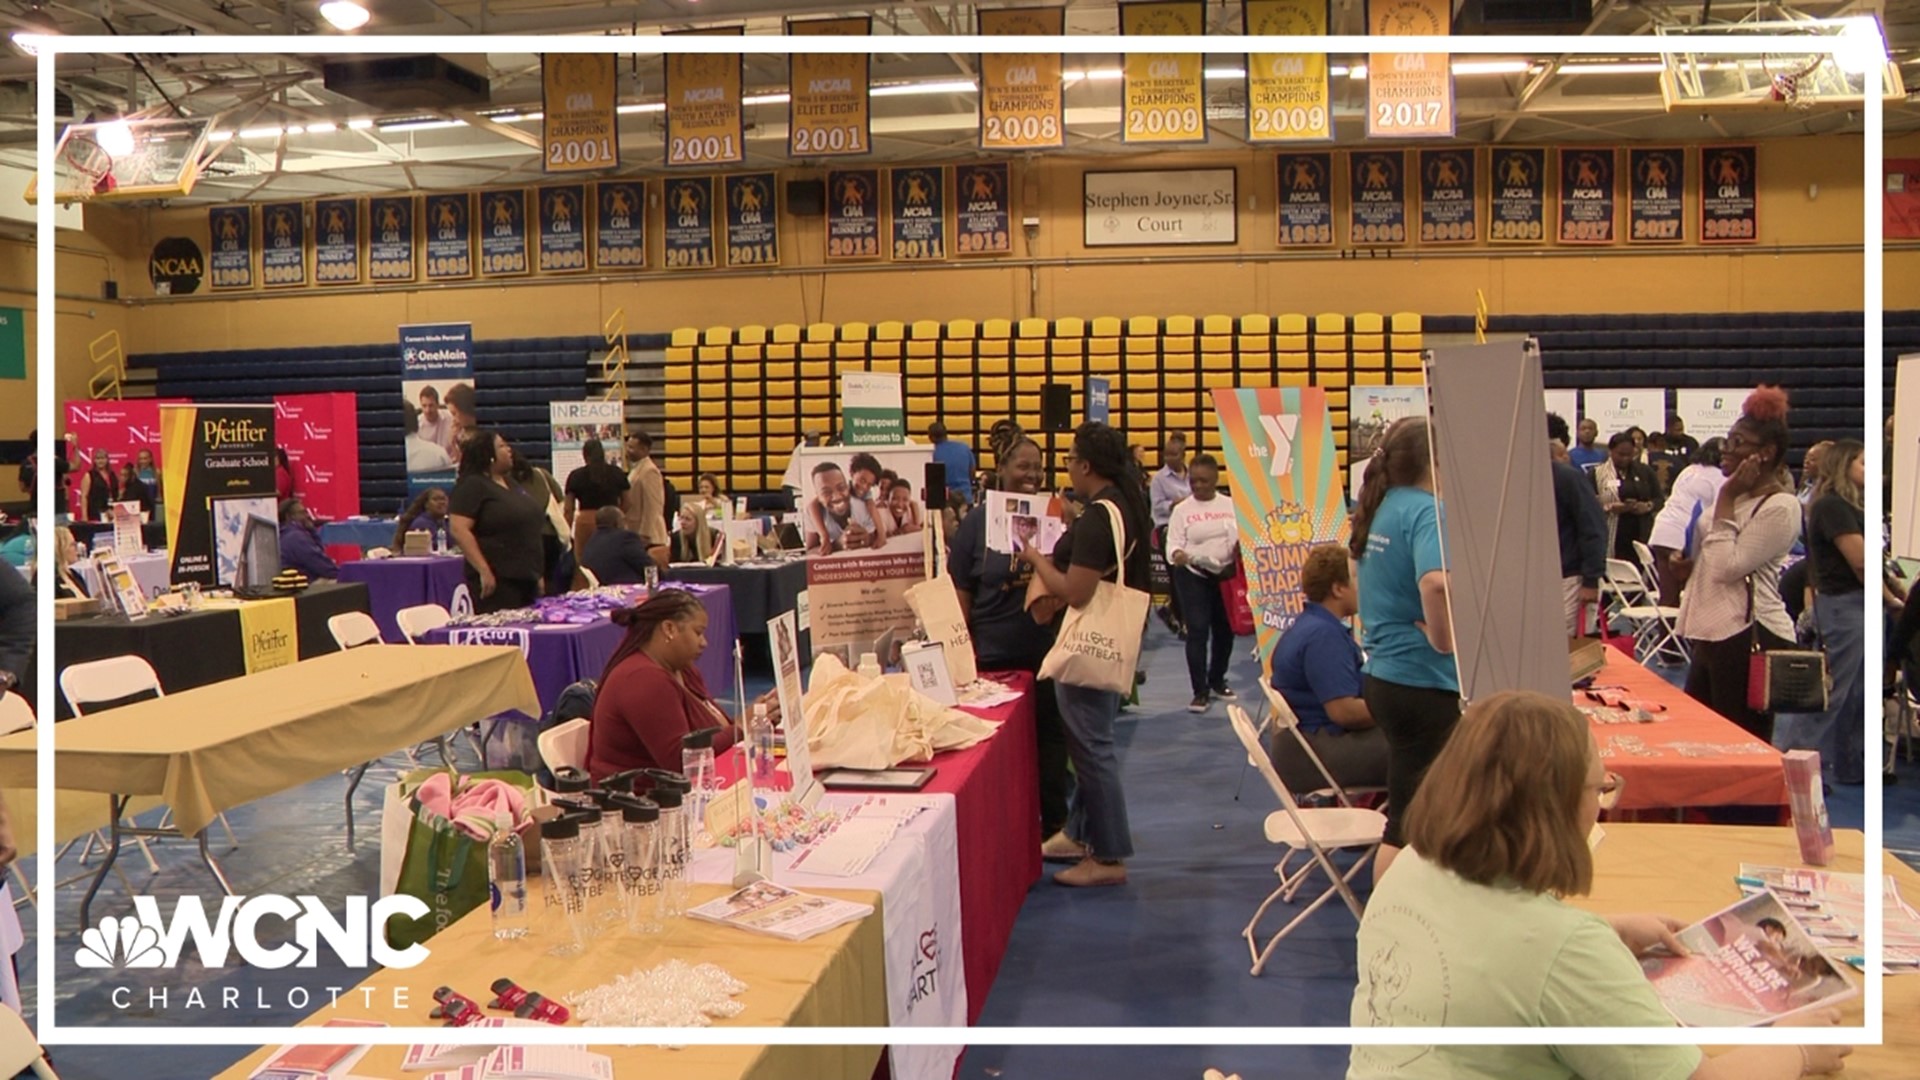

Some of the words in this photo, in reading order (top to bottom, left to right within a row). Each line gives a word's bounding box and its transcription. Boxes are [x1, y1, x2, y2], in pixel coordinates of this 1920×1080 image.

[808, 79, 852, 94] NCAA
[1012, 84, 1054, 92] BASKETBALL
[1130, 80, 1151, 88] MEN'S
[1153, 78, 1195, 86] BASKETBALL
[684, 88, 725, 103] NCAA
[1131, 93, 1196, 106] CHAMPIONS
[1256, 92, 1321, 104] CHAMPIONS
[1376, 86, 1443, 98] CHAMPIONS
[796, 104, 826, 116] ELITE
[830, 102, 860, 114] EIGHT
[989, 99, 1054, 112] CHAMPIONS
[1129, 108, 1198, 134] 2009
[1254, 106, 1325, 132] 2009
[1377, 102, 1443, 127] 2017
[551, 124, 609, 137] CHAMPIONS
[986, 115, 1058, 141] 2008
[795, 127, 861, 151] 2001
[550, 139, 612, 164] 2001
[672, 136, 735, 161] 2001
[1086, 192, 1149, 211] Stephen
[1154, 191, 1211, 209] Joyner,
[1213, 190, 1235, 205] Sr.
[1290, 192, 1320, 202] NCAA
[1362, 191, 1393, 201] NCAA
[1432, 190, 1464, 200] NCAA
[1502, 188, 1533, 199] NCAA
[1573, 188, 1603, 199] NCAA
[903, 207, 932, 217] NCAA
[968, 201, 998, 212] NCAA
[832, 226, 874, 235] RUNNER-UP
[1137, 216, 1183, 232] Court
[1493, 221, 1541, 238] 2009
[1564, 220, 1610, 239] 2017
[1634, 220, 1679, 238] 2017
[830, 236, 876, 256] 2012
[895, 238, 942, 258] 2011
[960, 231, 1007, 251] 2012
[667, 247, 712, 267] 2011
[730, 243, 776, 264] 2011
[152, 258, 201, 275] NCAA
[418, 350, 467, 362] OneMain
[70, 406, 94, 423] N
[552, 402, 621, 417] INREACH
[852, 418, 865, 427] We
[867, 419, 900, 429] empower
[203, 418, 267, 449] Pfeiffer
[853, 433, 890, 442] businesses
[891, 433, 900, 442] to
[1248, 442, 1268, 458] the
[1258, 414, 1299, 477] Y
[205, 457, 240, 469] Graduate
[243, 456, 269, 468] School
[180, 556, 202, 564] ONLINE
[813, 563, 841, 571] Connect
[859, 559, 892, 567] Resources
[893, 557, 907, 565] Who
[178, 564, 210, 574] IN-PERSON
[813, 572, 861, 582] UNDERSTAND
[885, 568, 905, 576] YOUR
[1263, 611, 1286, 630] DAY
[251, 630, 288, 659] Pfeiffer
[1720, 944, 1770, 994] HIRING!
[1733, 934, 1761, 962] WE
[1751, 960, 1788, 990] ARE
